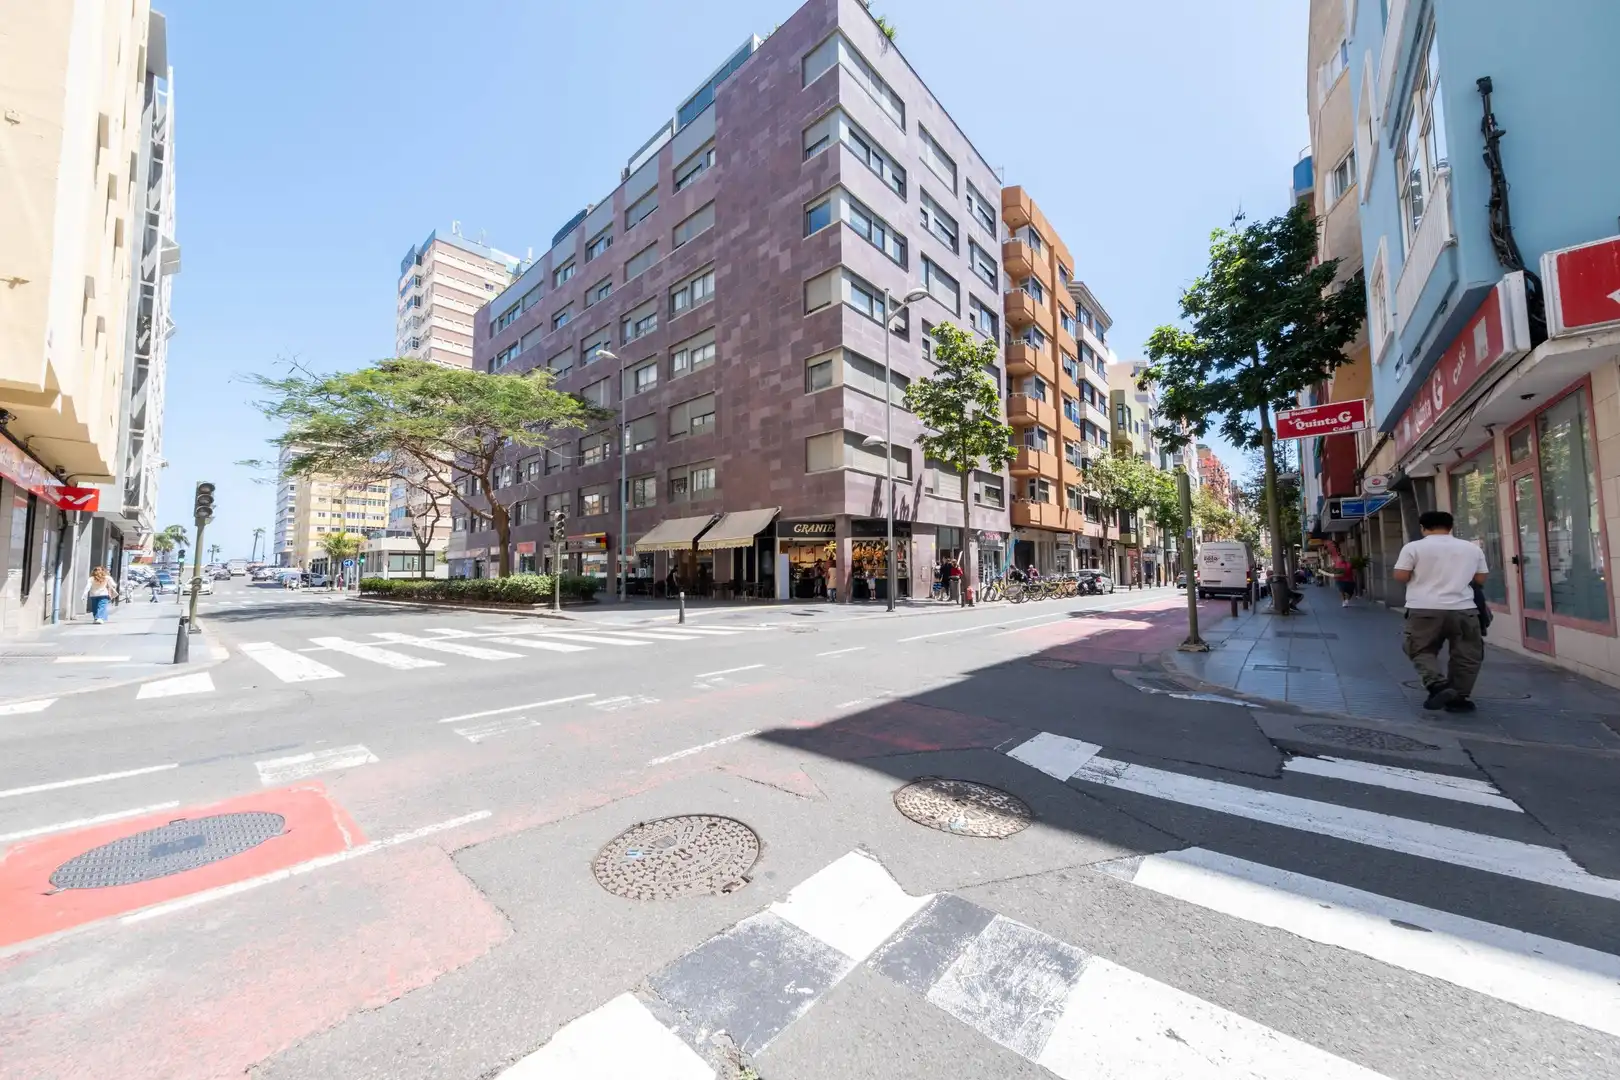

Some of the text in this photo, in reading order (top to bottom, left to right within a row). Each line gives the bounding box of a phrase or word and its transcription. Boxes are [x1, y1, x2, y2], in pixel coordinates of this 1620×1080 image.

[1432, 368, 1443, 410] G
[1295, 417, 1338, 431] Quinta
[1338, 411, 1353, 423] G
[793, 523, 836, 535] GRANIE
